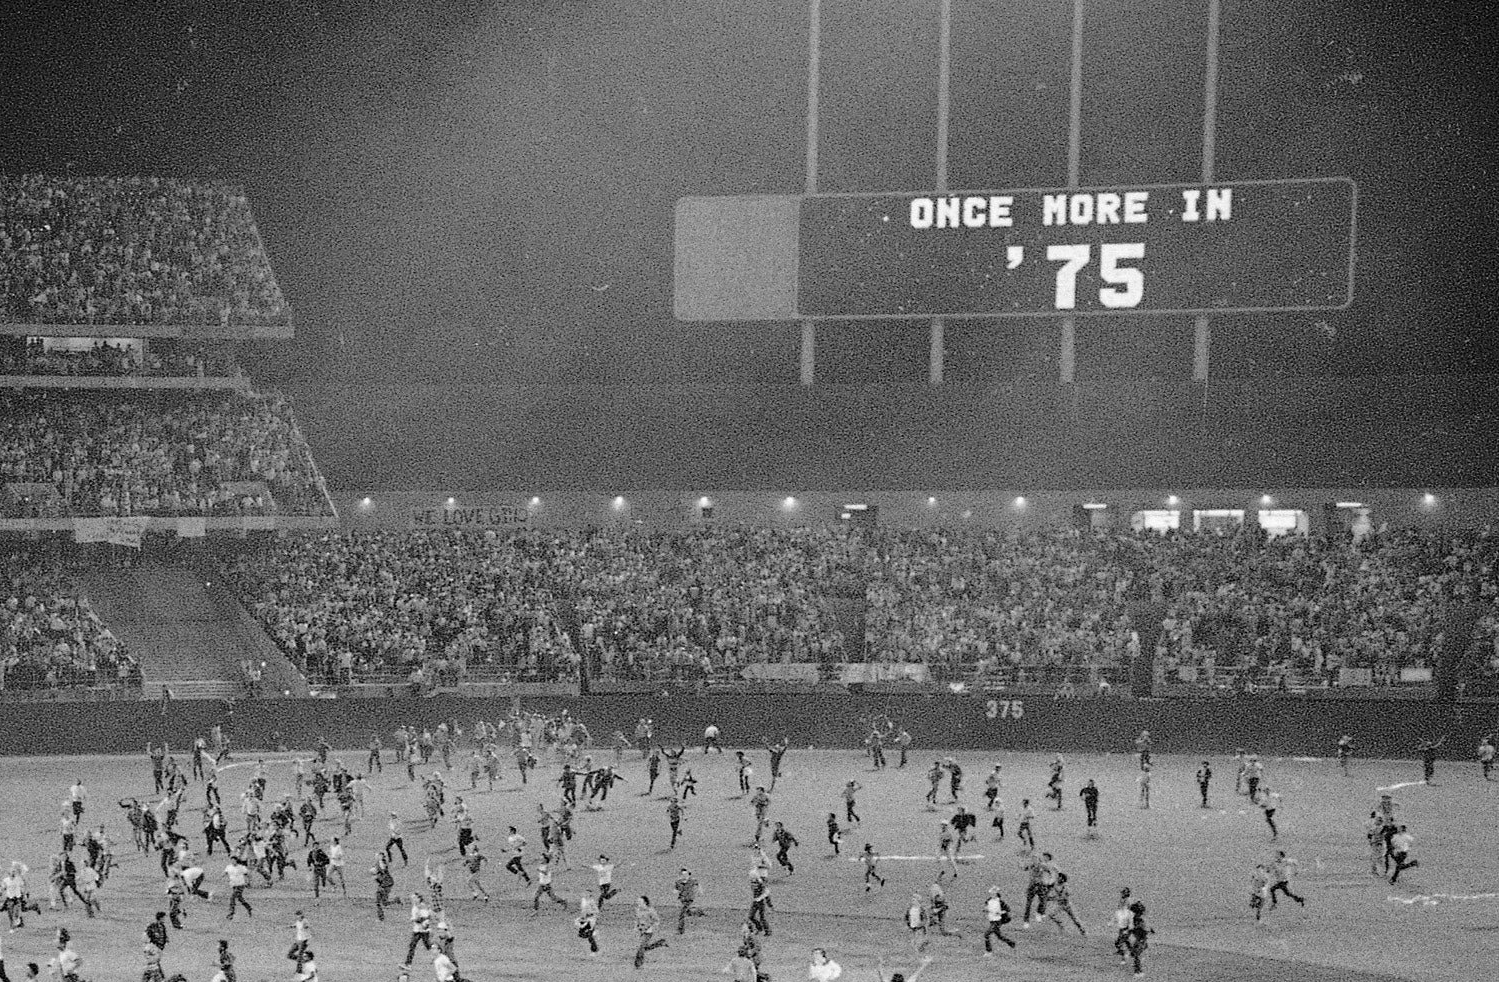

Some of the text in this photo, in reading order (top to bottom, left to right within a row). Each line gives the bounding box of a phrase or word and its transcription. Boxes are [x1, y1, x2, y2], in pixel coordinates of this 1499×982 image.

[910, 188, 1232, 229] ONCE MORE IN
[1007, 243, 1145, 309] '75
[444, 508, 485, 526] LOVE
[986, 700, 1023, 719] 375
